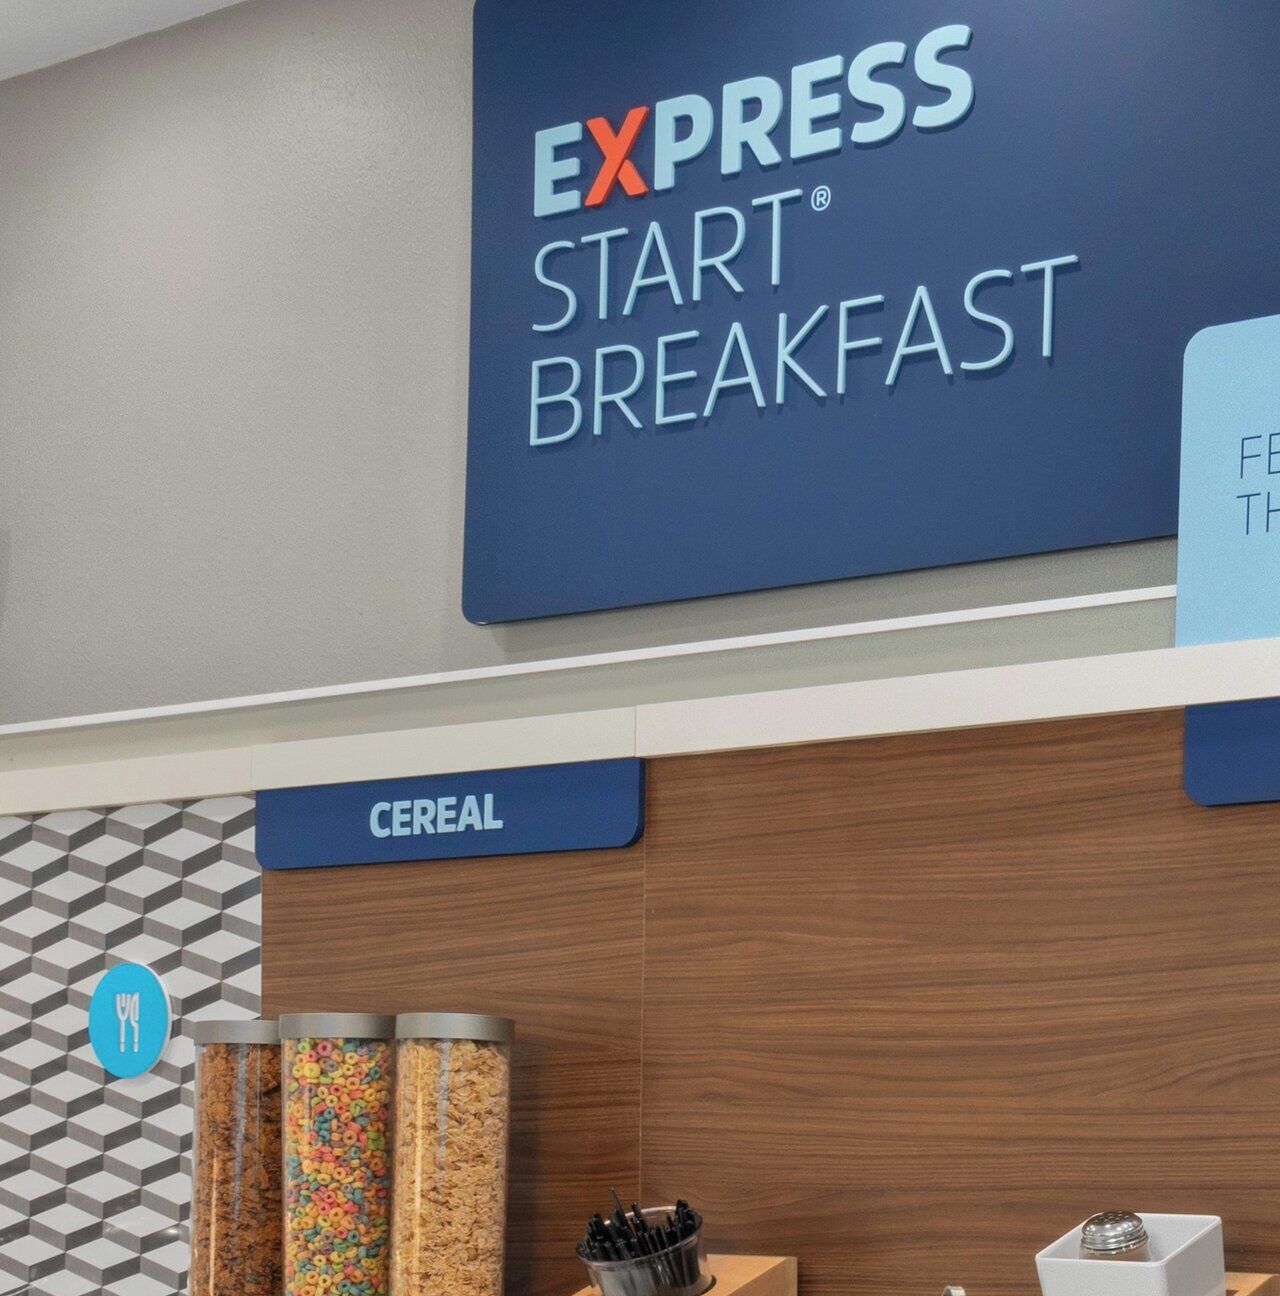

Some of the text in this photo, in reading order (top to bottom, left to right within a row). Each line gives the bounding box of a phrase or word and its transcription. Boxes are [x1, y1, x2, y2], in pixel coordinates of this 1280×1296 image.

[533, 24, 975, 218] EXPRESS
[529, 254, 1080, 447] BREAKFAST
[369, 793, 504, 838] CEREAL
